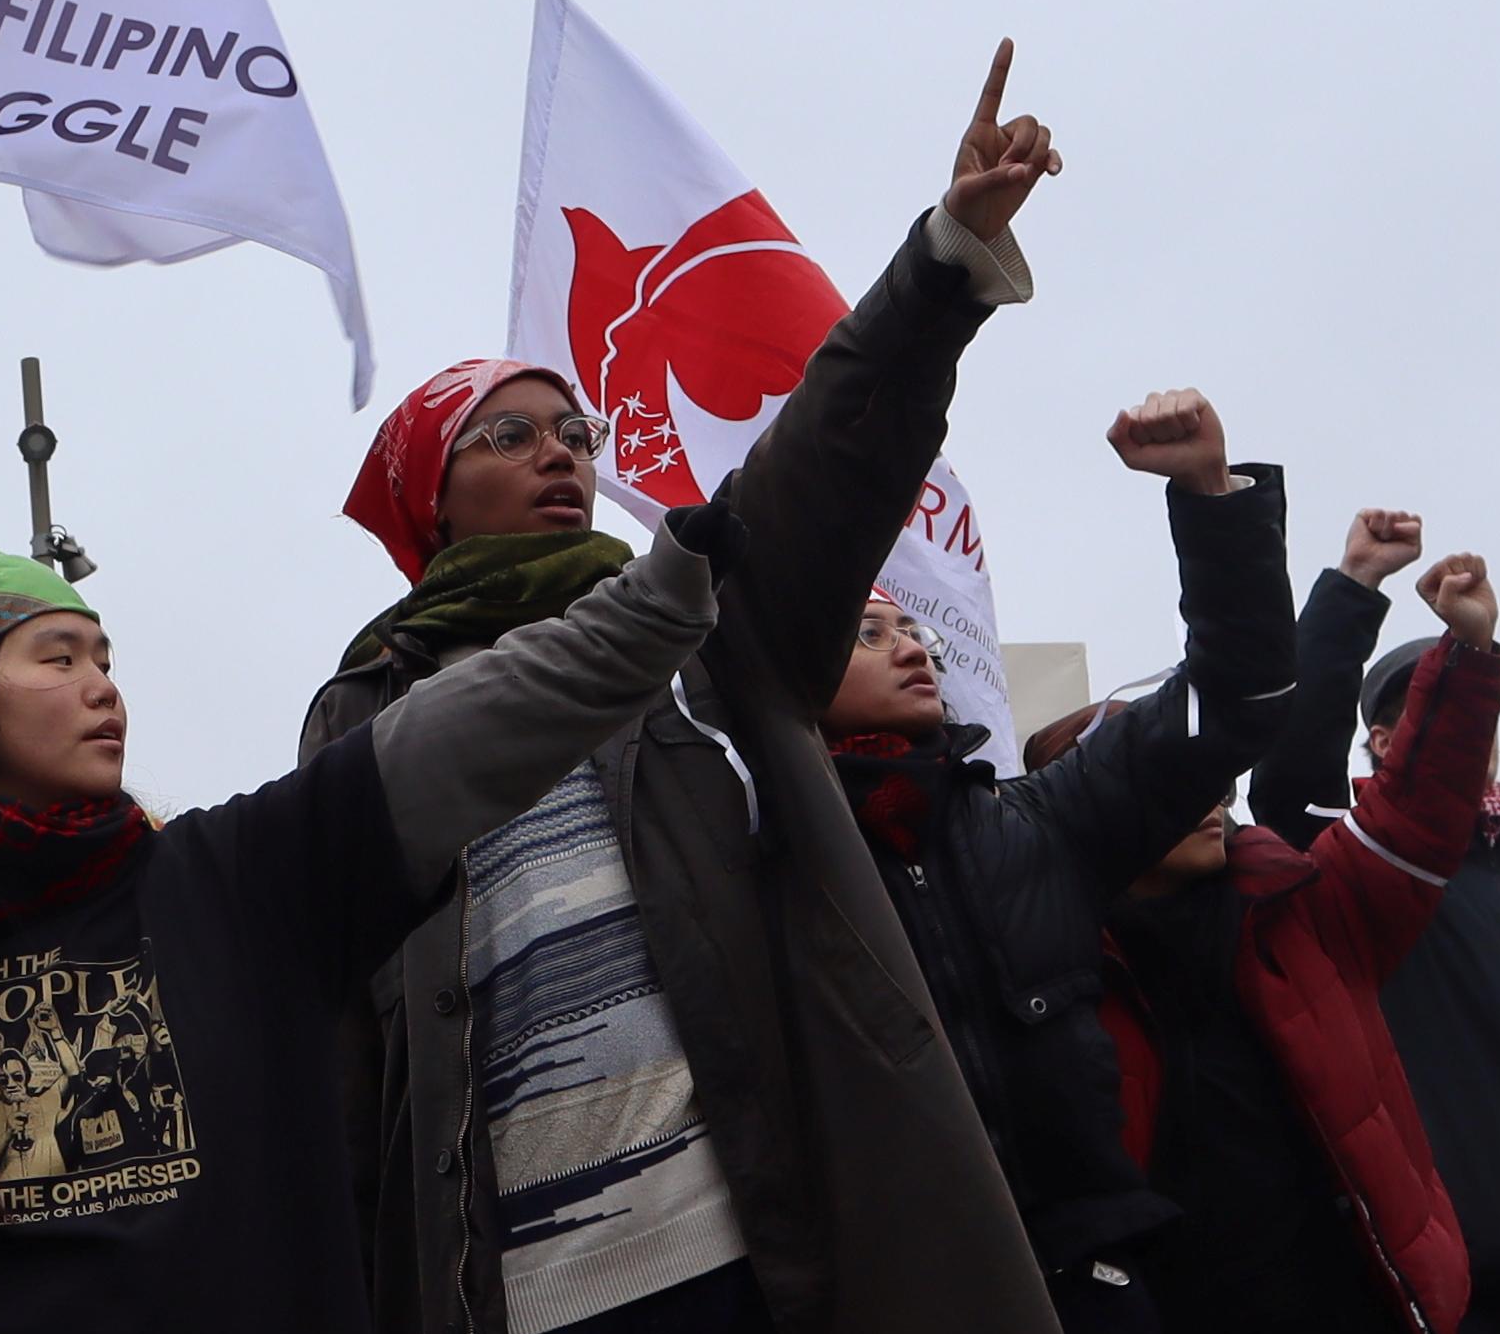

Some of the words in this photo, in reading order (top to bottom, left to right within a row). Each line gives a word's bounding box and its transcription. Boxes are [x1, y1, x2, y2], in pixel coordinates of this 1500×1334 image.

[903, 480, 985, 572] RM
[875, 575, 940, 619] ational
[942, 640, 971, 670] he
[16, 946, 62, 976] THE
[51, 1156, 201, 1205] OPPRESSED
[53, 1206, 74, 1219] OF
[75, 1201, 105, 1217] LUIS
[106, 1187, 179, 1212] JALANDONI
